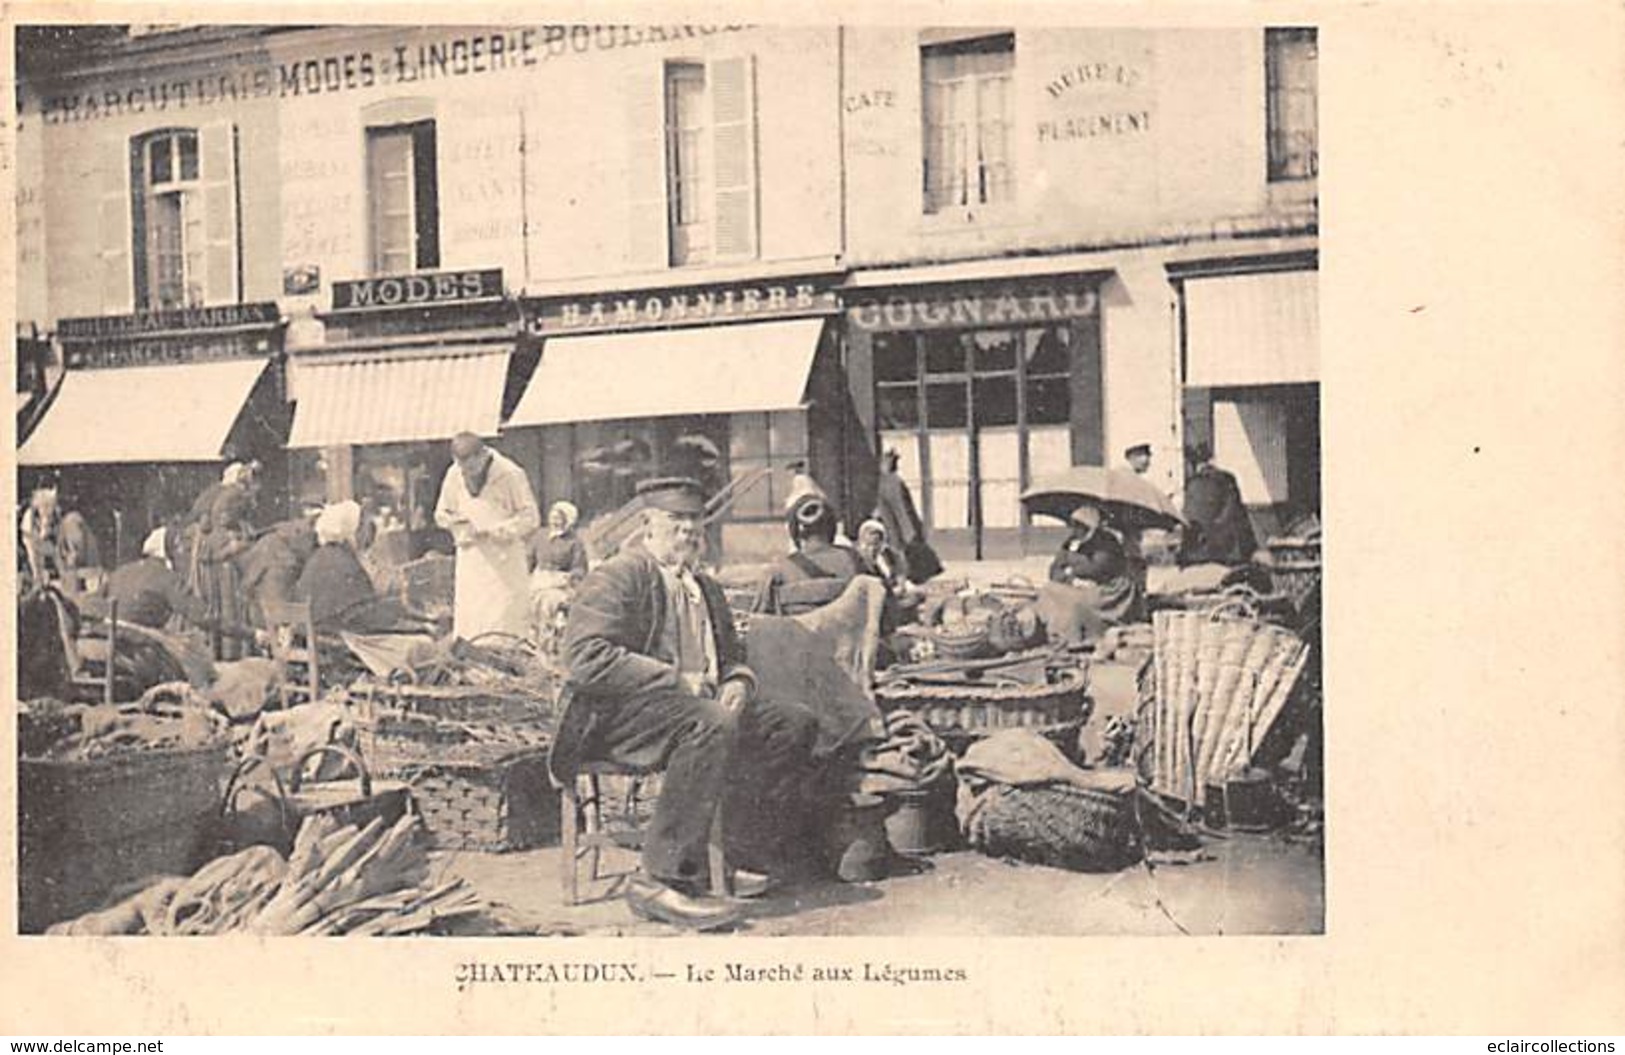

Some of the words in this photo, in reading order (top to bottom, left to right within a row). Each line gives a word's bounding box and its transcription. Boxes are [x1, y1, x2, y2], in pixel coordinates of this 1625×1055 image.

[279, 53, 375, 97] MODES
[393, 31, 538, 81] LINGERIE
[1036, 110, 1151, 142] PLACEMENT
[349, 272, 484, 307] MODES
